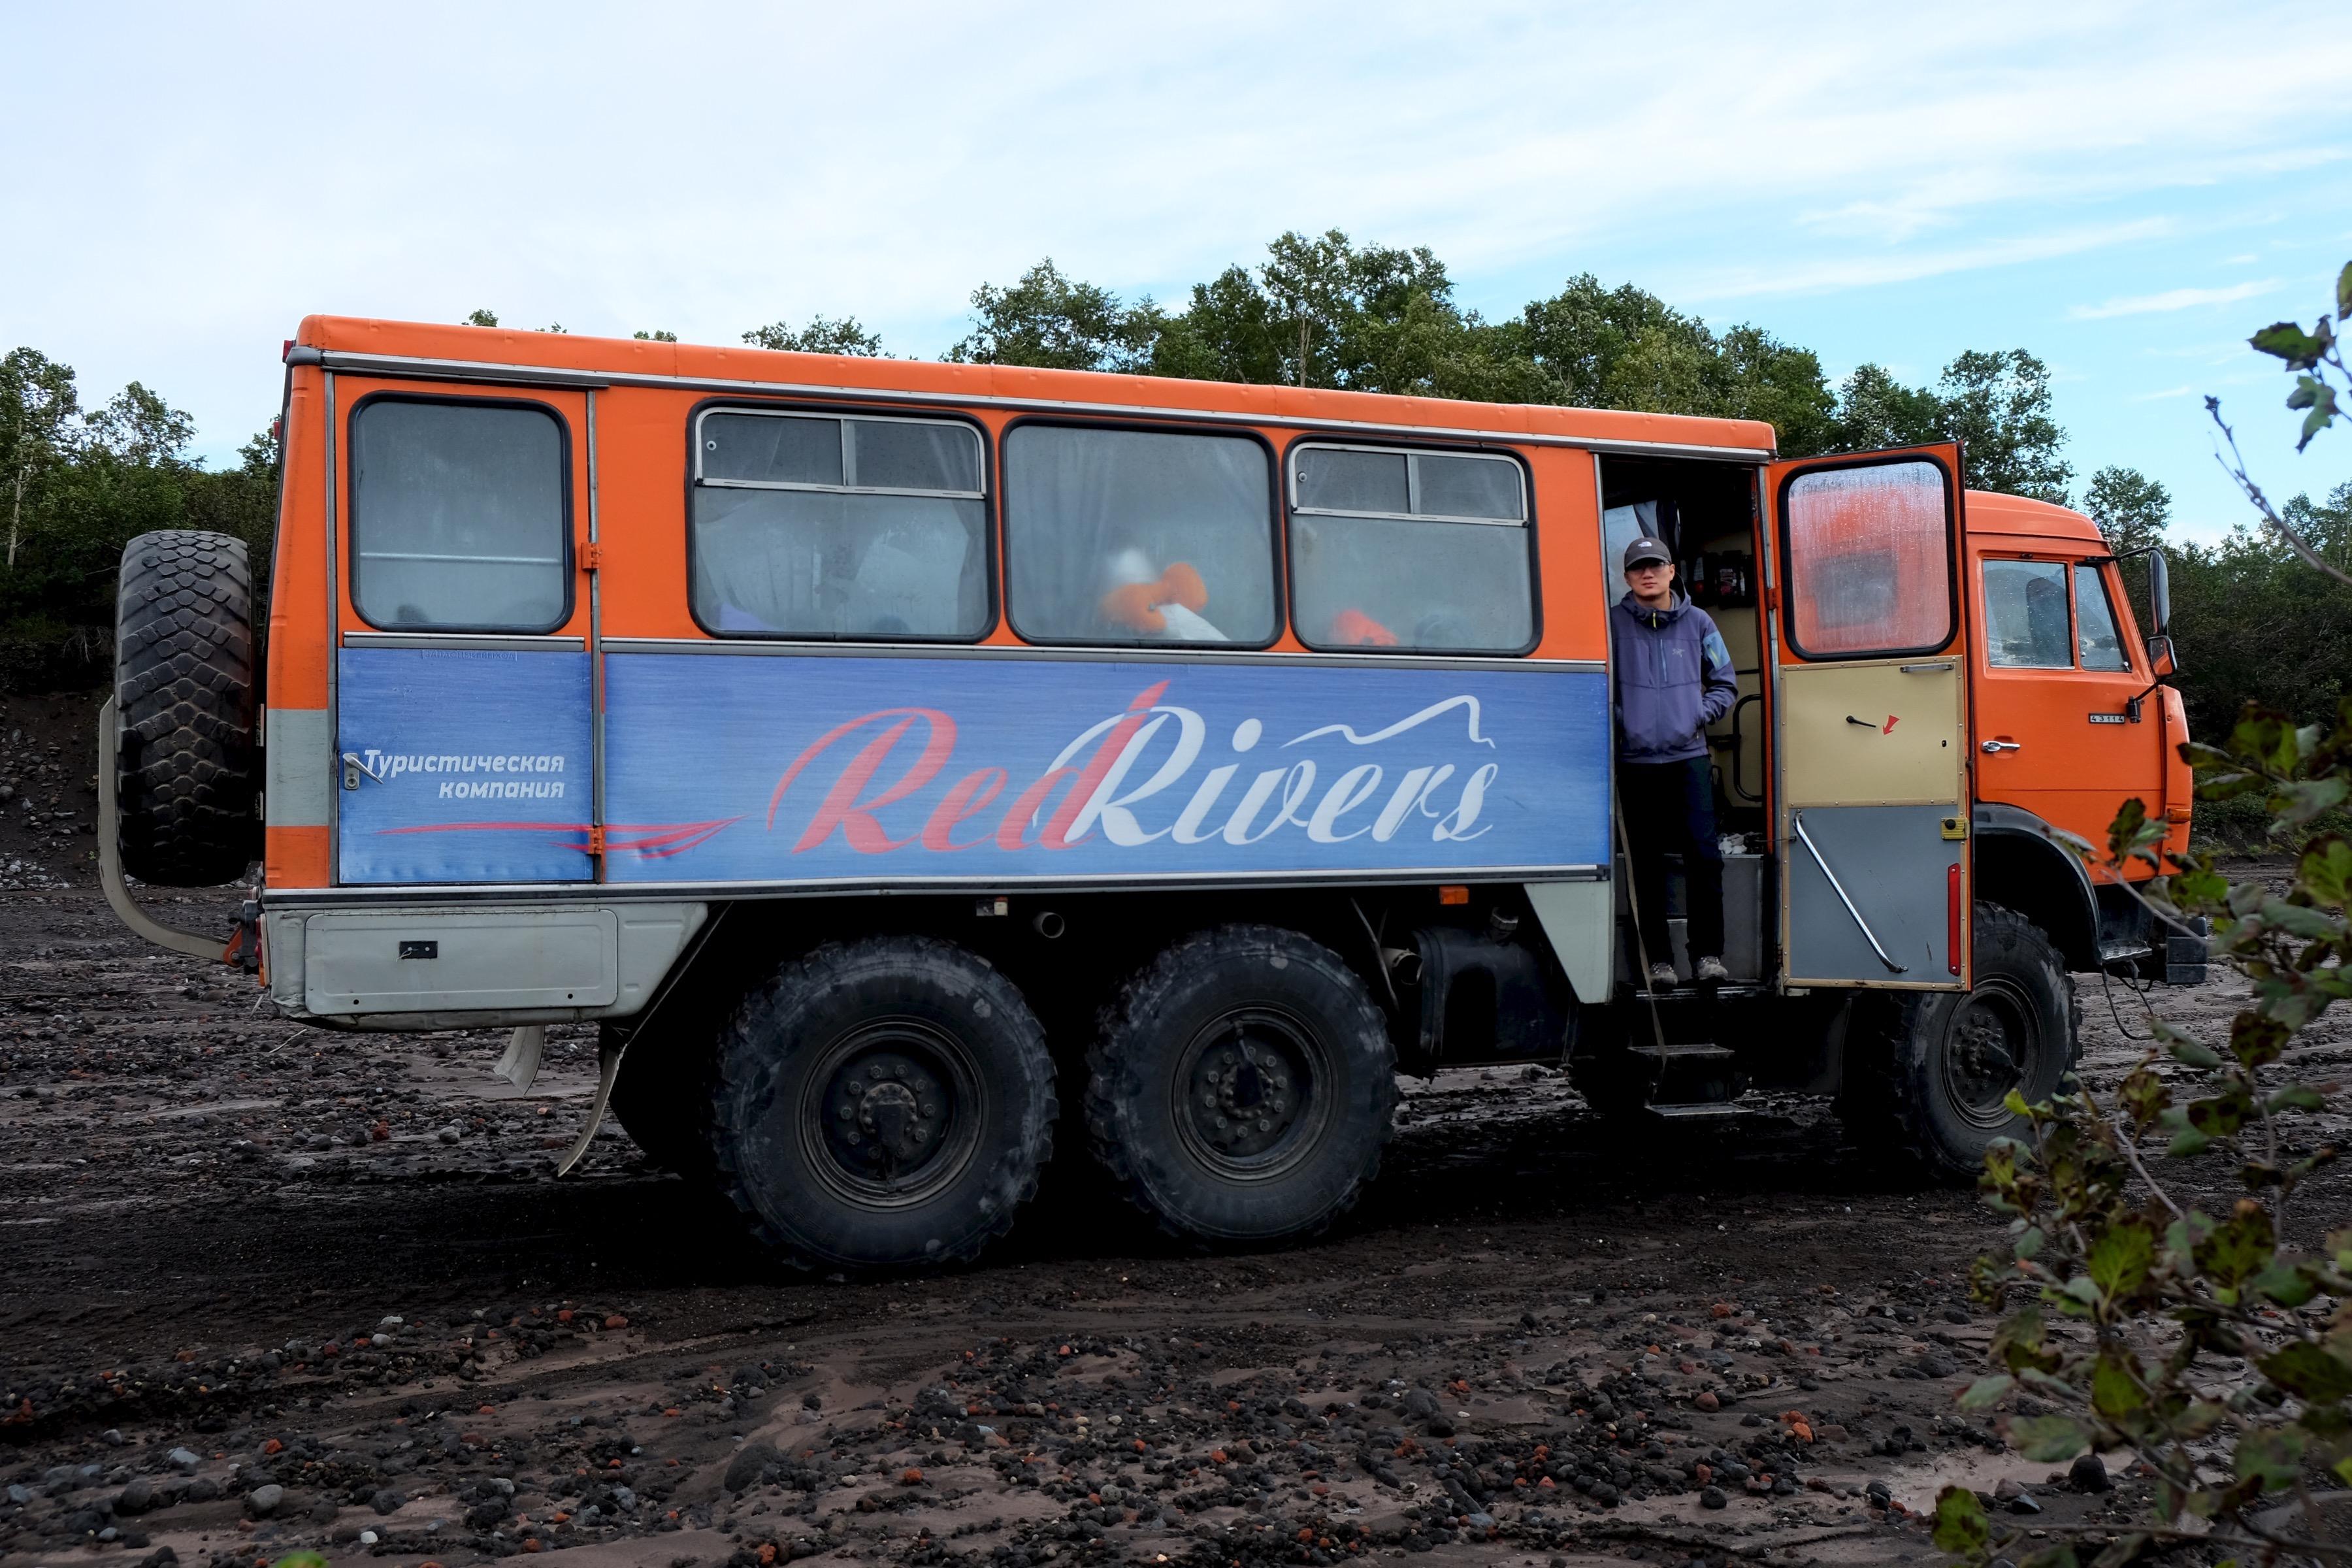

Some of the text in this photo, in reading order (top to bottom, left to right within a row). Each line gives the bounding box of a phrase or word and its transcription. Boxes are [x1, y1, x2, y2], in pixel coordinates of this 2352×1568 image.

[365, 749, 565, 778] Туристическая
[768, 679, 1498, 853] Red Rivers
[438, 781, 565, 798] компания
